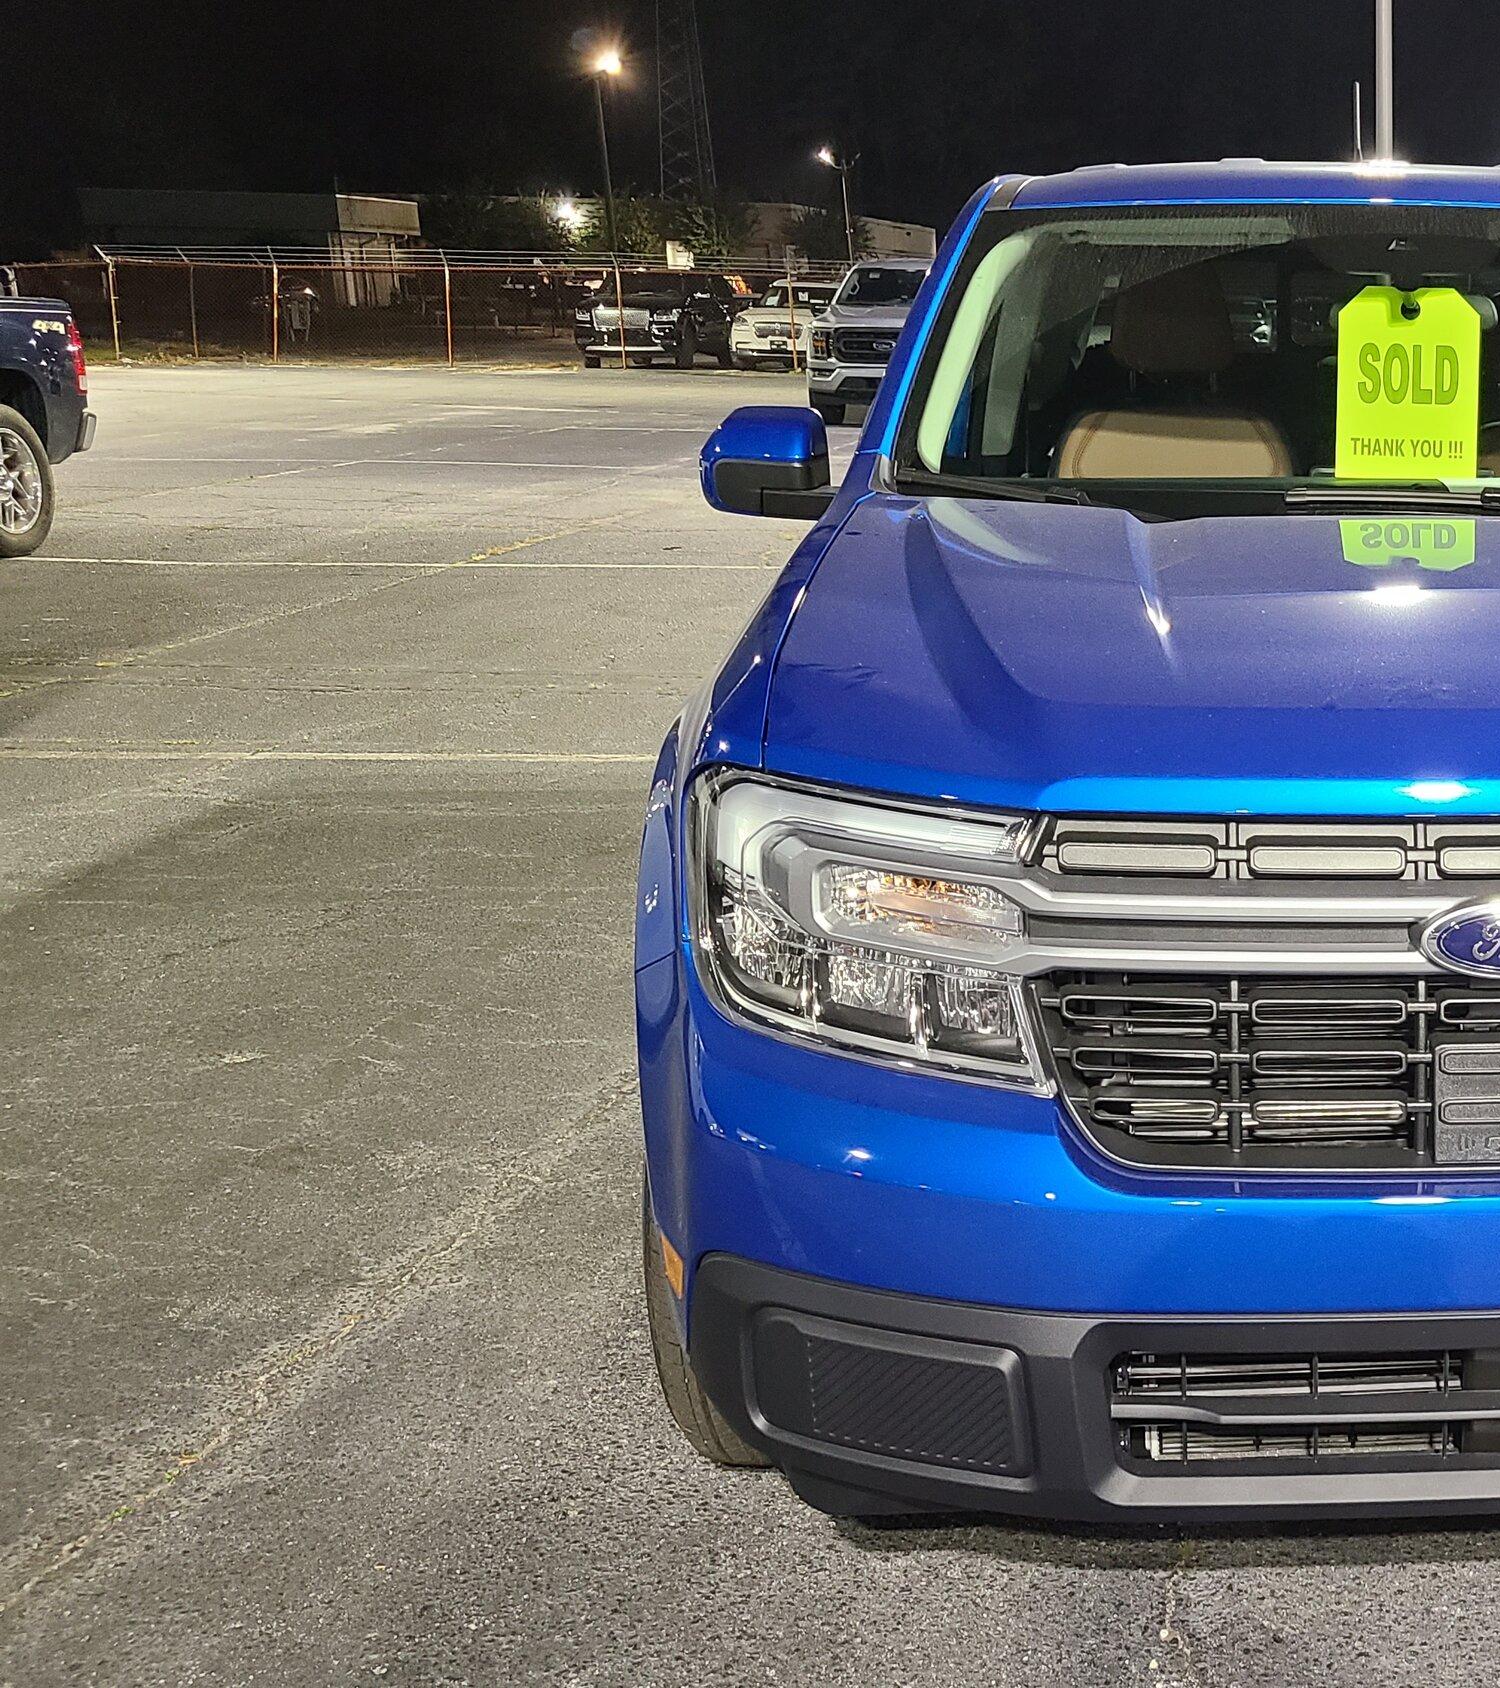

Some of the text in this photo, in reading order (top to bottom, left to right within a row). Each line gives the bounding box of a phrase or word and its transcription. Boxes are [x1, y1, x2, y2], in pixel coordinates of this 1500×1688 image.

[1357, 342, 1459, 405] SOLD
[1350, 437, 1463, 459] THANK YOU !!!
